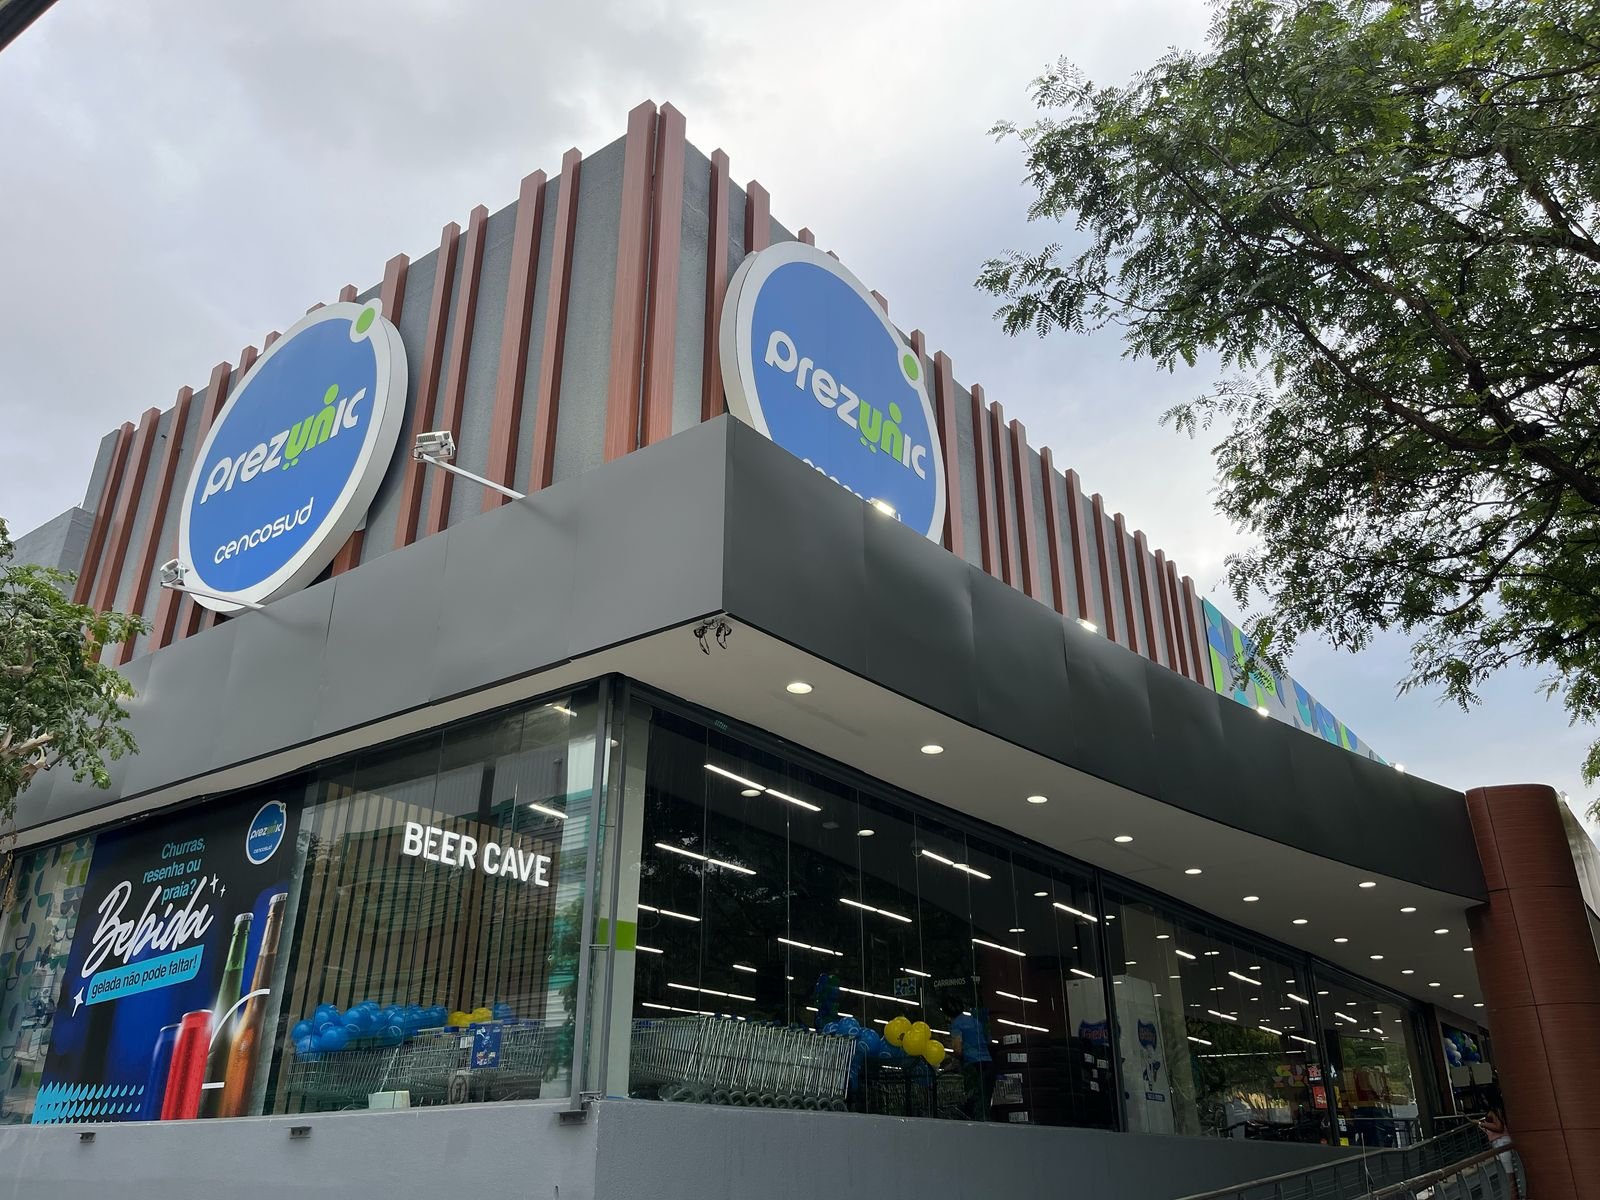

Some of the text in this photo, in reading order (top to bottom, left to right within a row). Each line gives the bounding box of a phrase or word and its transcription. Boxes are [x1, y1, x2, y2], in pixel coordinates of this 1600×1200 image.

[213, 496, 315, 565] cencosud
[142, 858, 202, 884] resenha ou
[161, 838, 206, 860] Churras,
[403, 821, 551, 887] BEER CAVE
[160, 878, 198, 906] praia?
[81, 876, 214, 979] Bebida
[91, 954, 198, 999] gelada não pode faltar!
